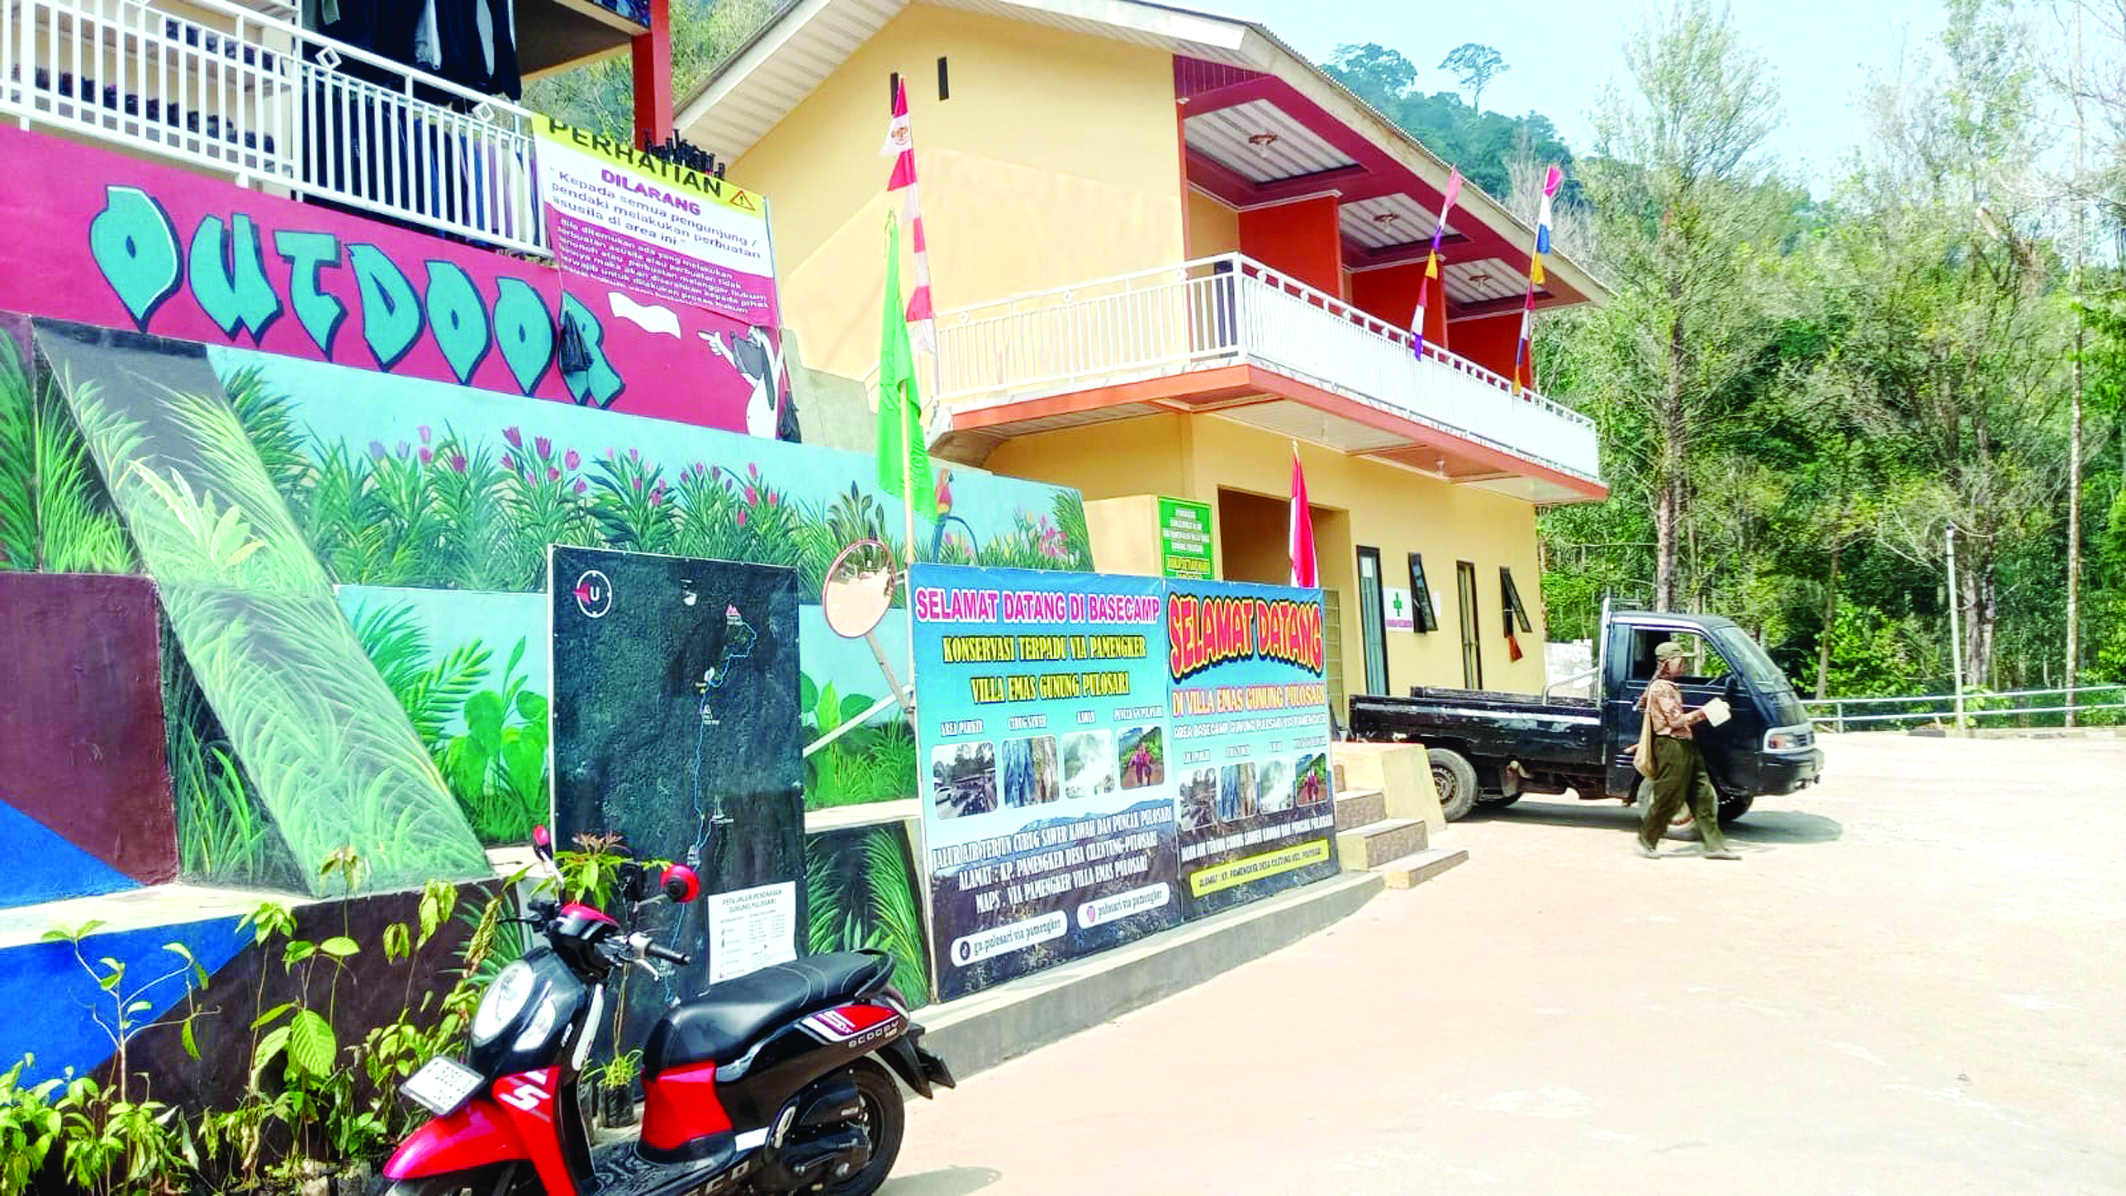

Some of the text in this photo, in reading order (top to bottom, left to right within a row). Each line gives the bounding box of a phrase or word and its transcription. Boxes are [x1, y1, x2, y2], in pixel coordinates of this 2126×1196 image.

[549, 118, 721, 197] PERHATIAN
[559, 171, 615, 199] Kepada
[620, 195, 667, 217] semua
[671, 213, 747, 246] pengunjung
[602, 169, 701, 216] DILARANG
[552, 182, 761, 259] pendaki melakukan perbuatan
[553, 195, 603, 220] asusila
[608, 216, 621, 226] di
[625, 222, 657, 238] area
[661, 232, 677, 245] ini
[581, 226, 635, 249] ditemukan
[682, 259, 733, 279] melakukan
[89, 184, 626, 410] OUTDOOR
[590, 586, 599, 601] U
[916, 587, 1161, 624] SELAMAT DATANG DI BASECAMP
[943, 635, 1146, 663] KONSERVASI TERPADU VIA PAMENGKER
[1168, 592, 1323, 684] SELAMAT DATANG
[971, 671, 1130, 704] VILLA EMAS GUNUNG PULOSARI
[1172, 688, 1184, 717] DI
[1185, 688, 1215, 716] VILLA
[1216, 686, 1244, 713] EMAS
[1245, 684, 1284, 711] GUNUNG
[1285, 682, 1325, 709] PULOSARI
[961, 841, 979, 862] AIR
[979, 835, 1012, 860] TERJUN
[1013, 829, 1040, 853] CURUG
[1097, 817, 1112, 835] DAN
[959, 865, 992, 892] ALAMAT
[1016, 850, 1065, 877] PAMENGKER
[1065, 845, 1085, 866] DESA
[976, 889, 1000, 914] MAPS
[1007, 885, 1023, 905] VIA
[1024, 872, 1072, 901] PAMENGKER
[1073, 867, 1095, 888] VILLA
[1095, 862, 1114, 883] EMAS
